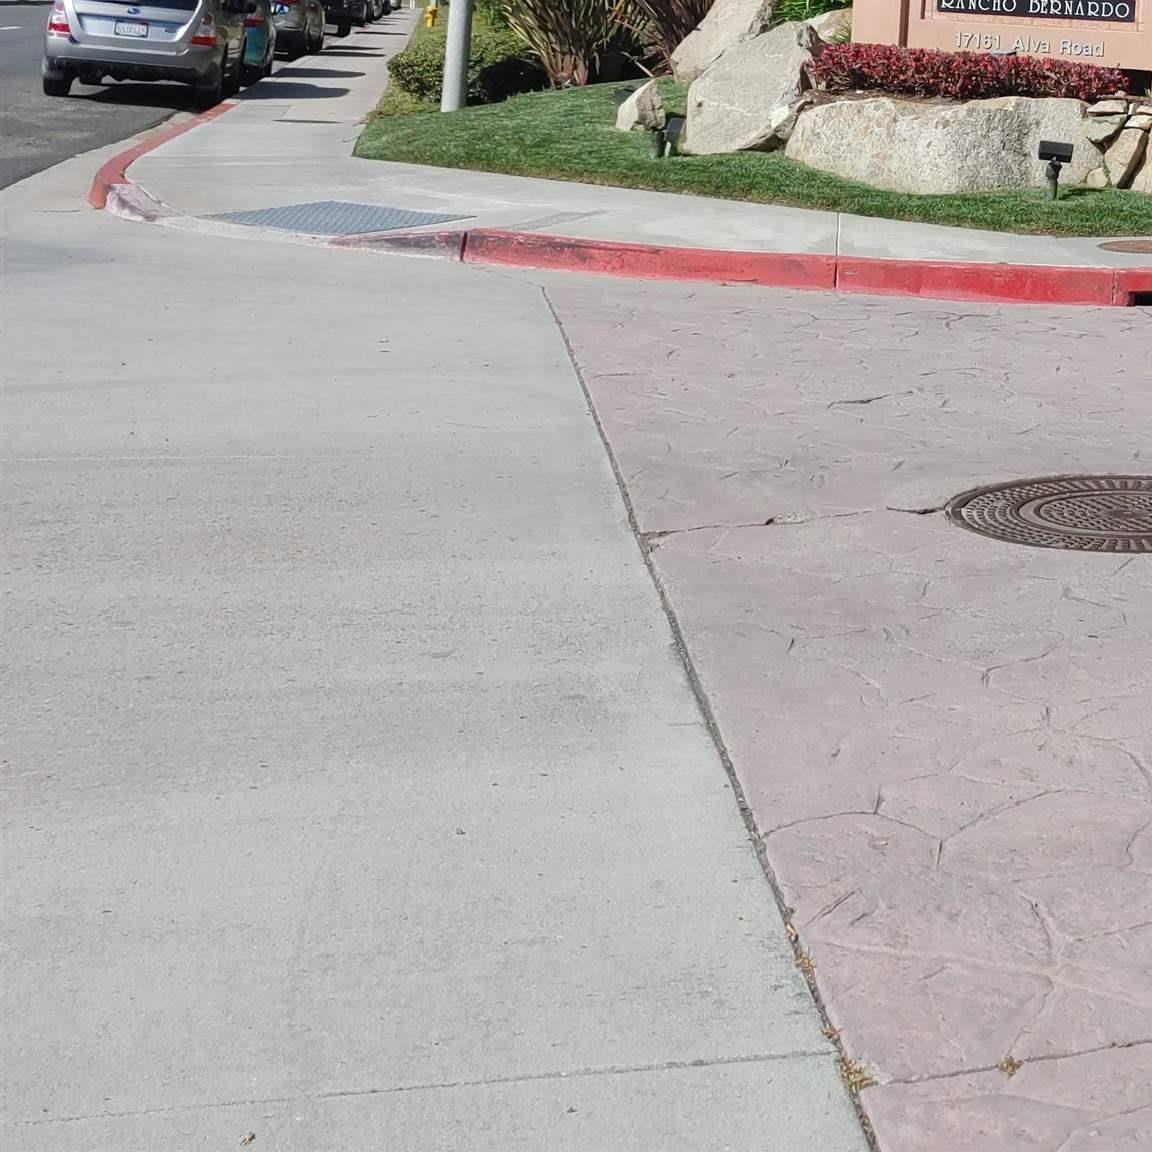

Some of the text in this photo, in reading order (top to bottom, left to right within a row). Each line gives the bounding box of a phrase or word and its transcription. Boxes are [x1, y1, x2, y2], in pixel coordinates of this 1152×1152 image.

[954, 31, 1105, 57] 17161 Alva Road
